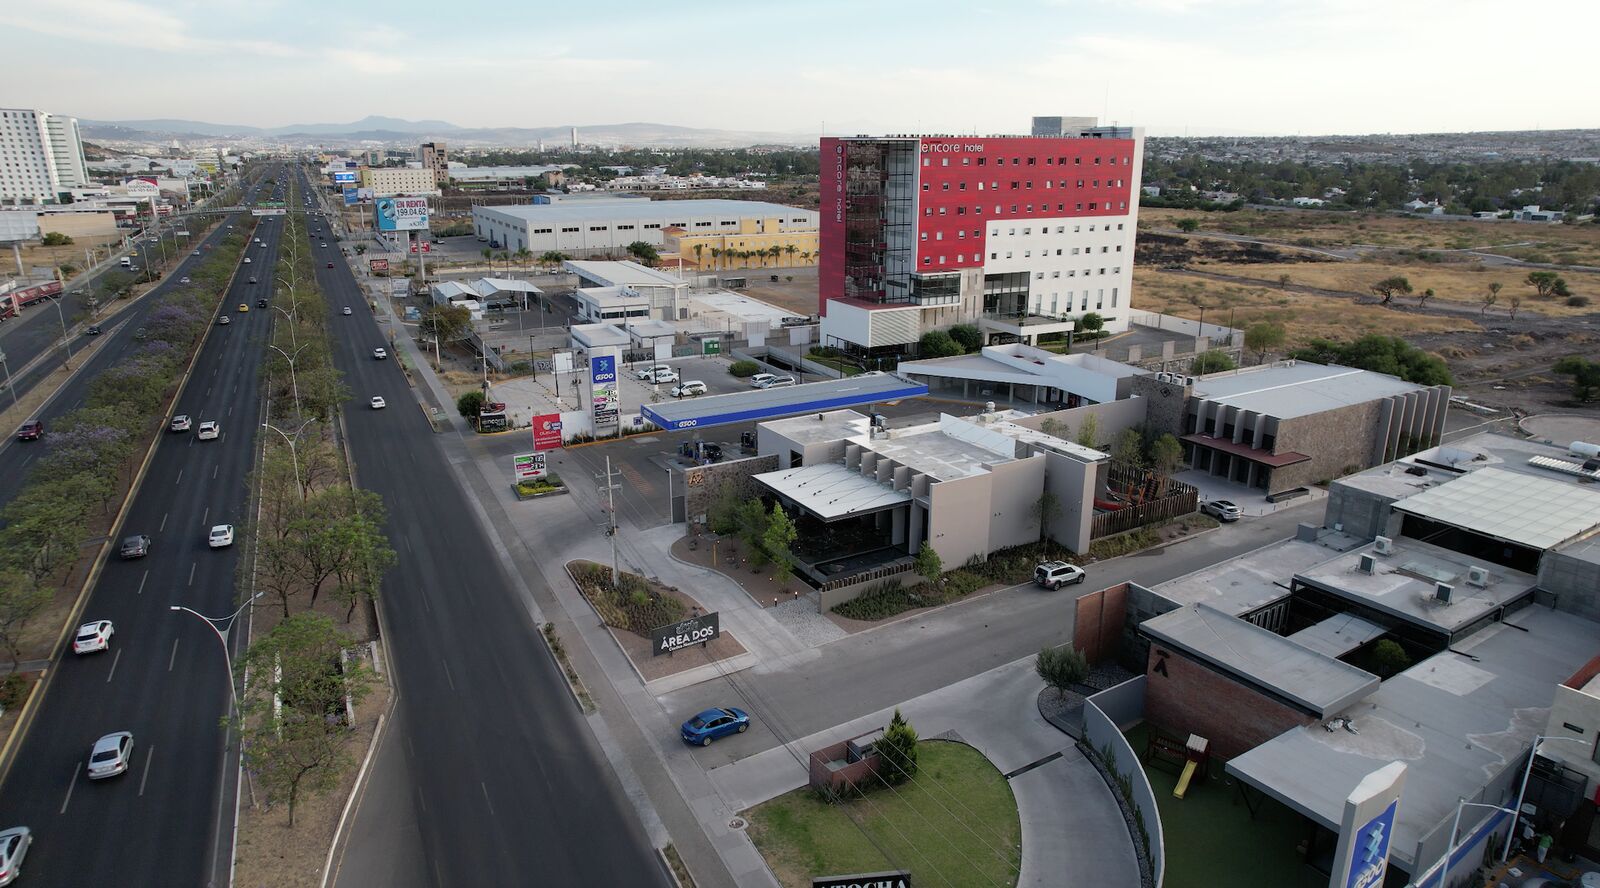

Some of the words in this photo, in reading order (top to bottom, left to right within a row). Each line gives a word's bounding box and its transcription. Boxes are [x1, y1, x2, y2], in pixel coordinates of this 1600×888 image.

[921, 143, 960, 153] encore
[964, 143, 984, 153] hotel
[396, 200, 405, 208] EN
[406, 200, 427, 208] RENTA
[661, 633, 690, 650] ÁREA
[692, 626, 714, 641] DOS
